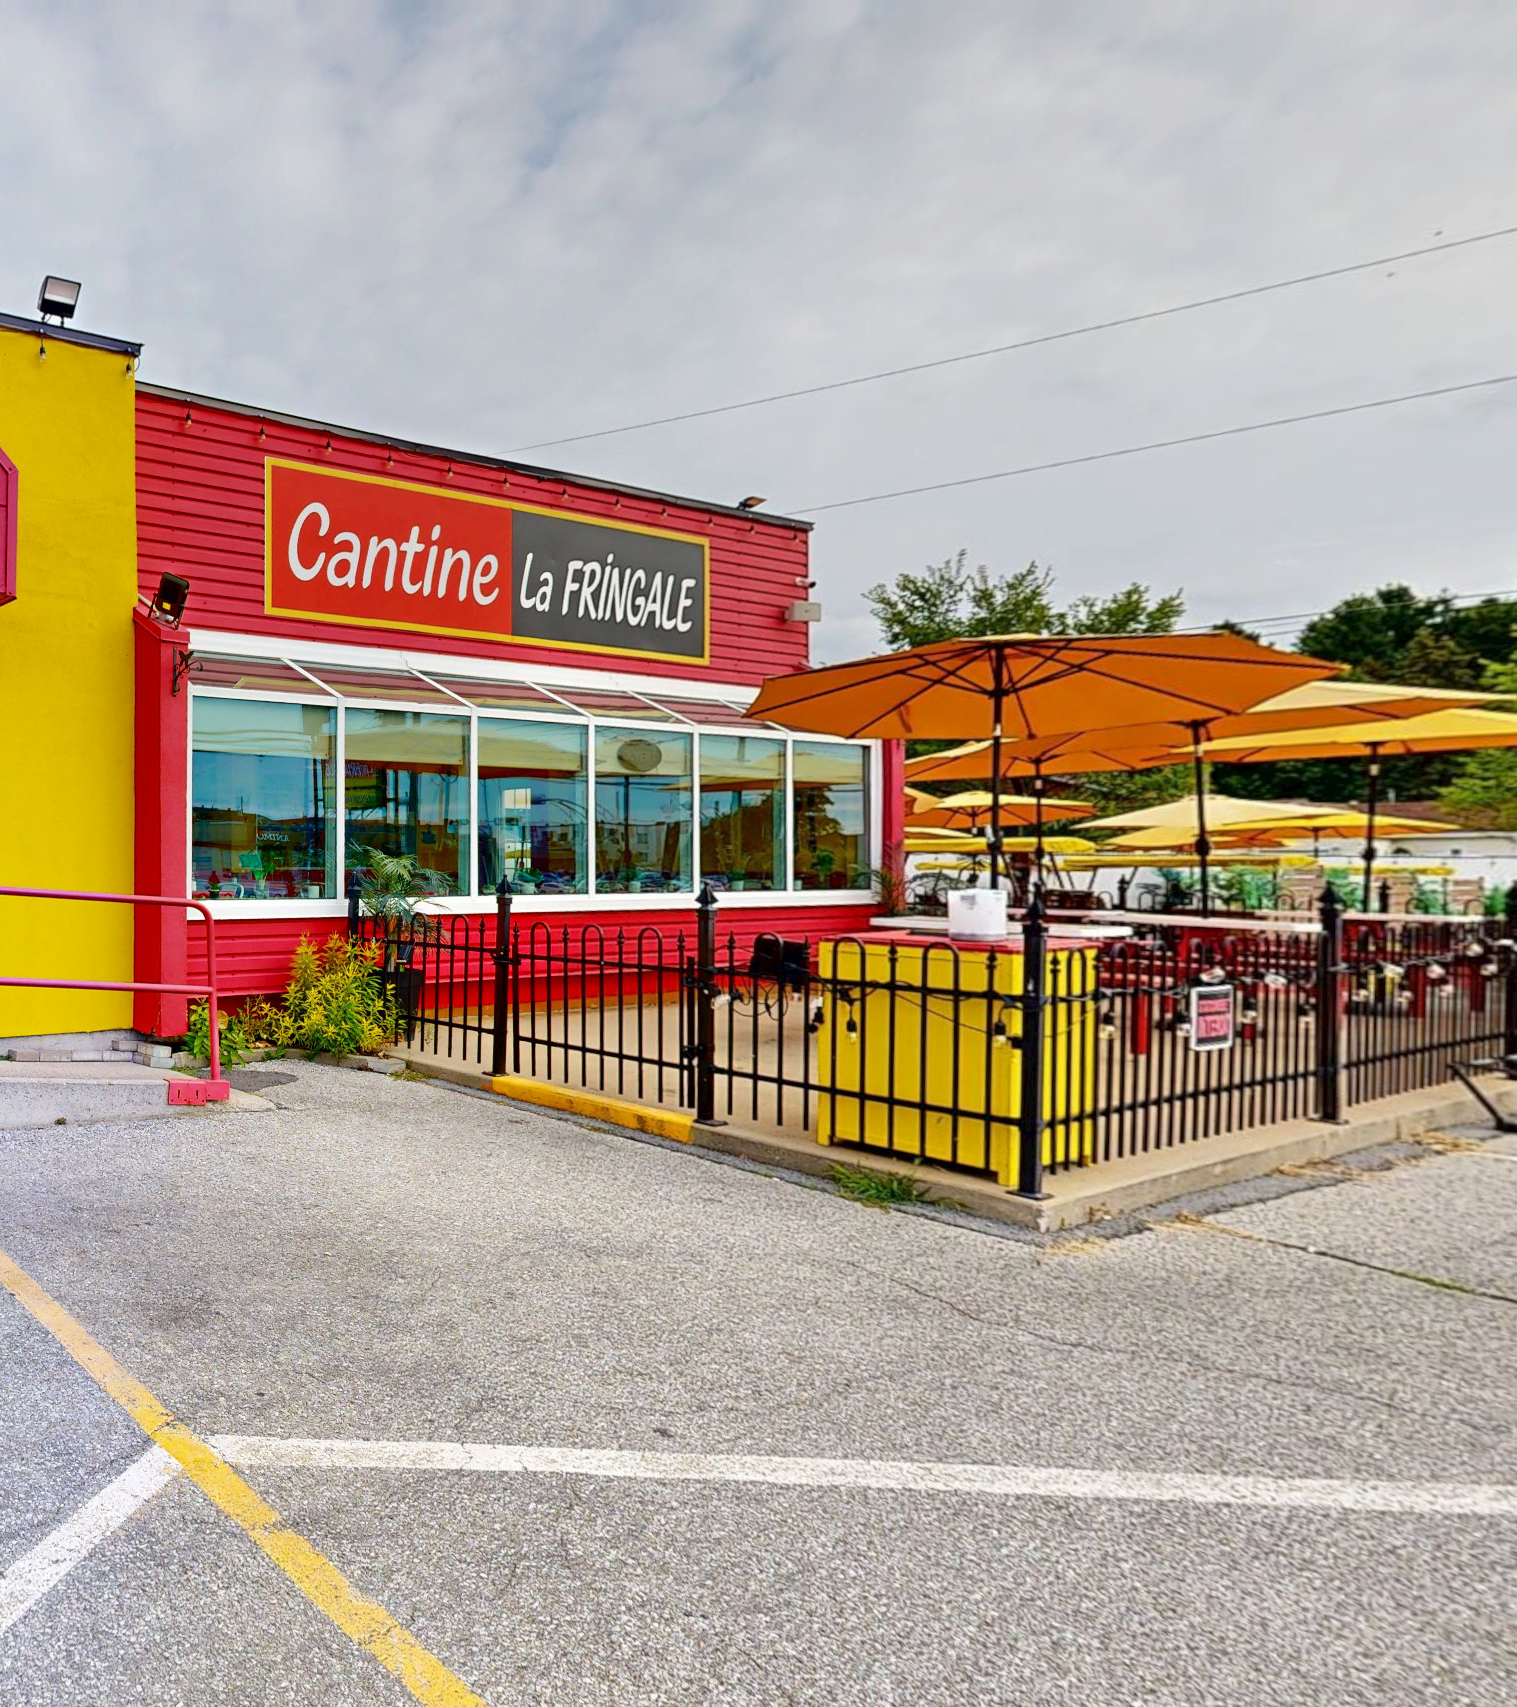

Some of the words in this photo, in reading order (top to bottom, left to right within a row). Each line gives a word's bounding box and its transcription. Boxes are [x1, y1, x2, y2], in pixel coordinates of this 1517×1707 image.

[288, 502, 500, 607] Cantine
[520, 552, 553, 613] La
[561, 552, 698, 633] FRINGALE
